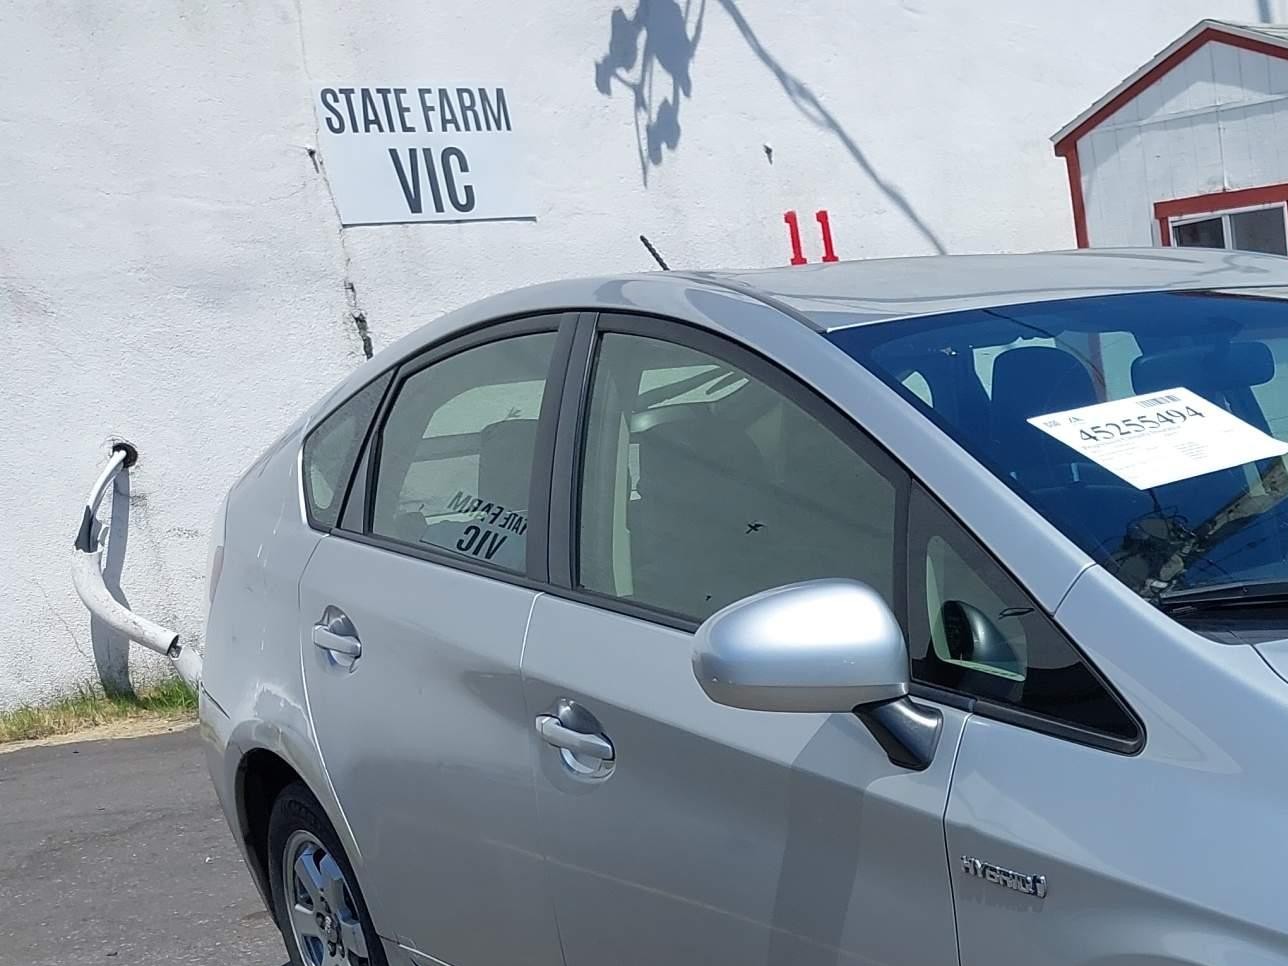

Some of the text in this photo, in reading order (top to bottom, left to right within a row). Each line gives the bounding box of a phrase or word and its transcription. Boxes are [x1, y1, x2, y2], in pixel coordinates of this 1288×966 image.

[320, 86, 512, 135] STATE FARM
[388, 146, 475, 214] VIC
[784, 210, 839, 265] 11
[1079, 406, 1205, 441] 45255494
